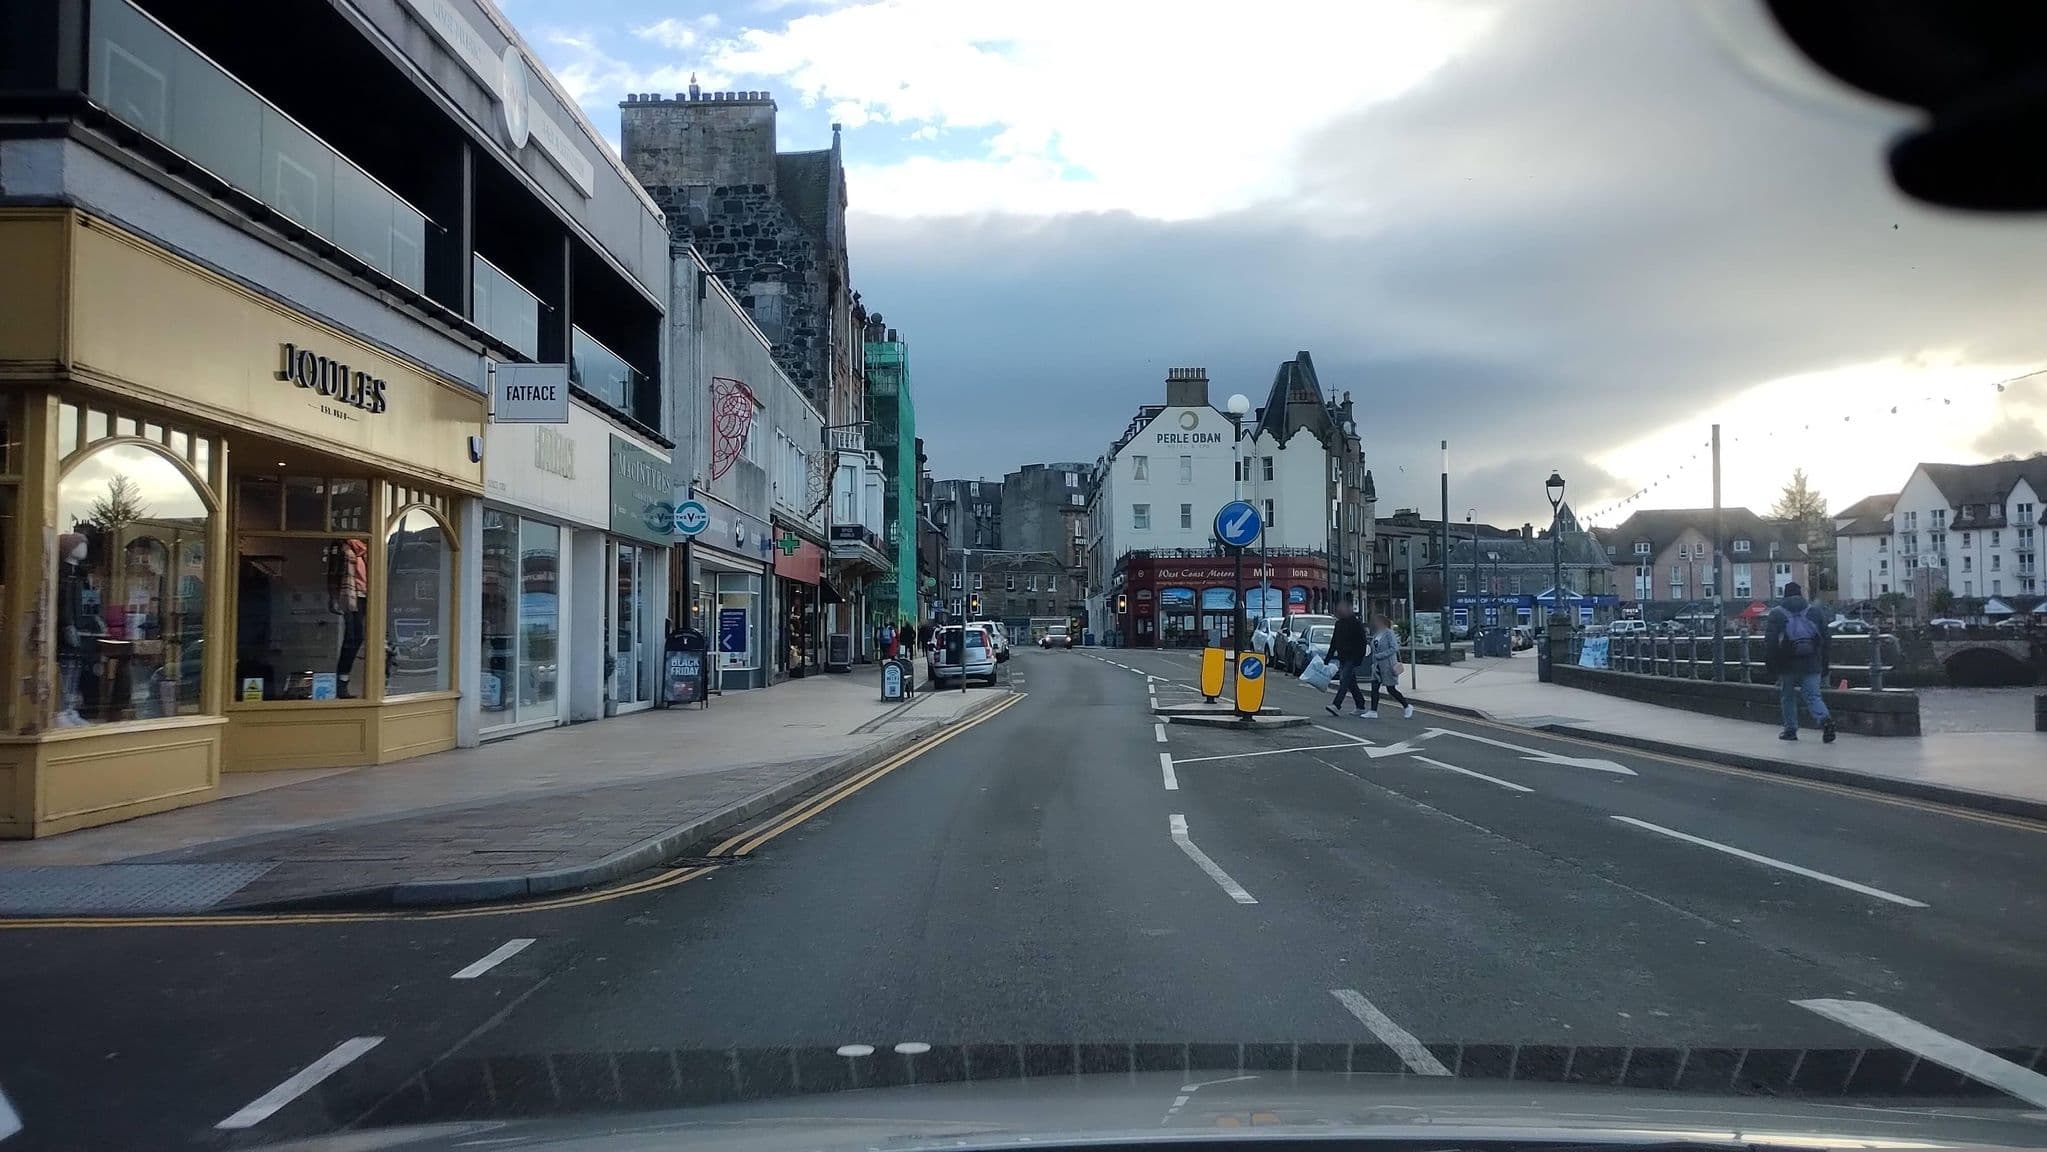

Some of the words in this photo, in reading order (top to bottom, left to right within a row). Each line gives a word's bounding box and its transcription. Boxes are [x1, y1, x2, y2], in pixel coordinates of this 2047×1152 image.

[274, 342, 386, 414] JOULES
[506, 385, 556, 401] FATFACE
[1156, 433, 1189, 444] PERLE
[1192, 432, 1221, 443] OBAN
[1158, 569, 1179, 578] West
[1181, 569, 1205, 577] Coast
[1206, 569, 1236, 577] Motors
[1292, 569, 1308, 577] Iona
[671, 656, 700, 667] BLACK
[671, 666, 700, 676] FRIDAY
